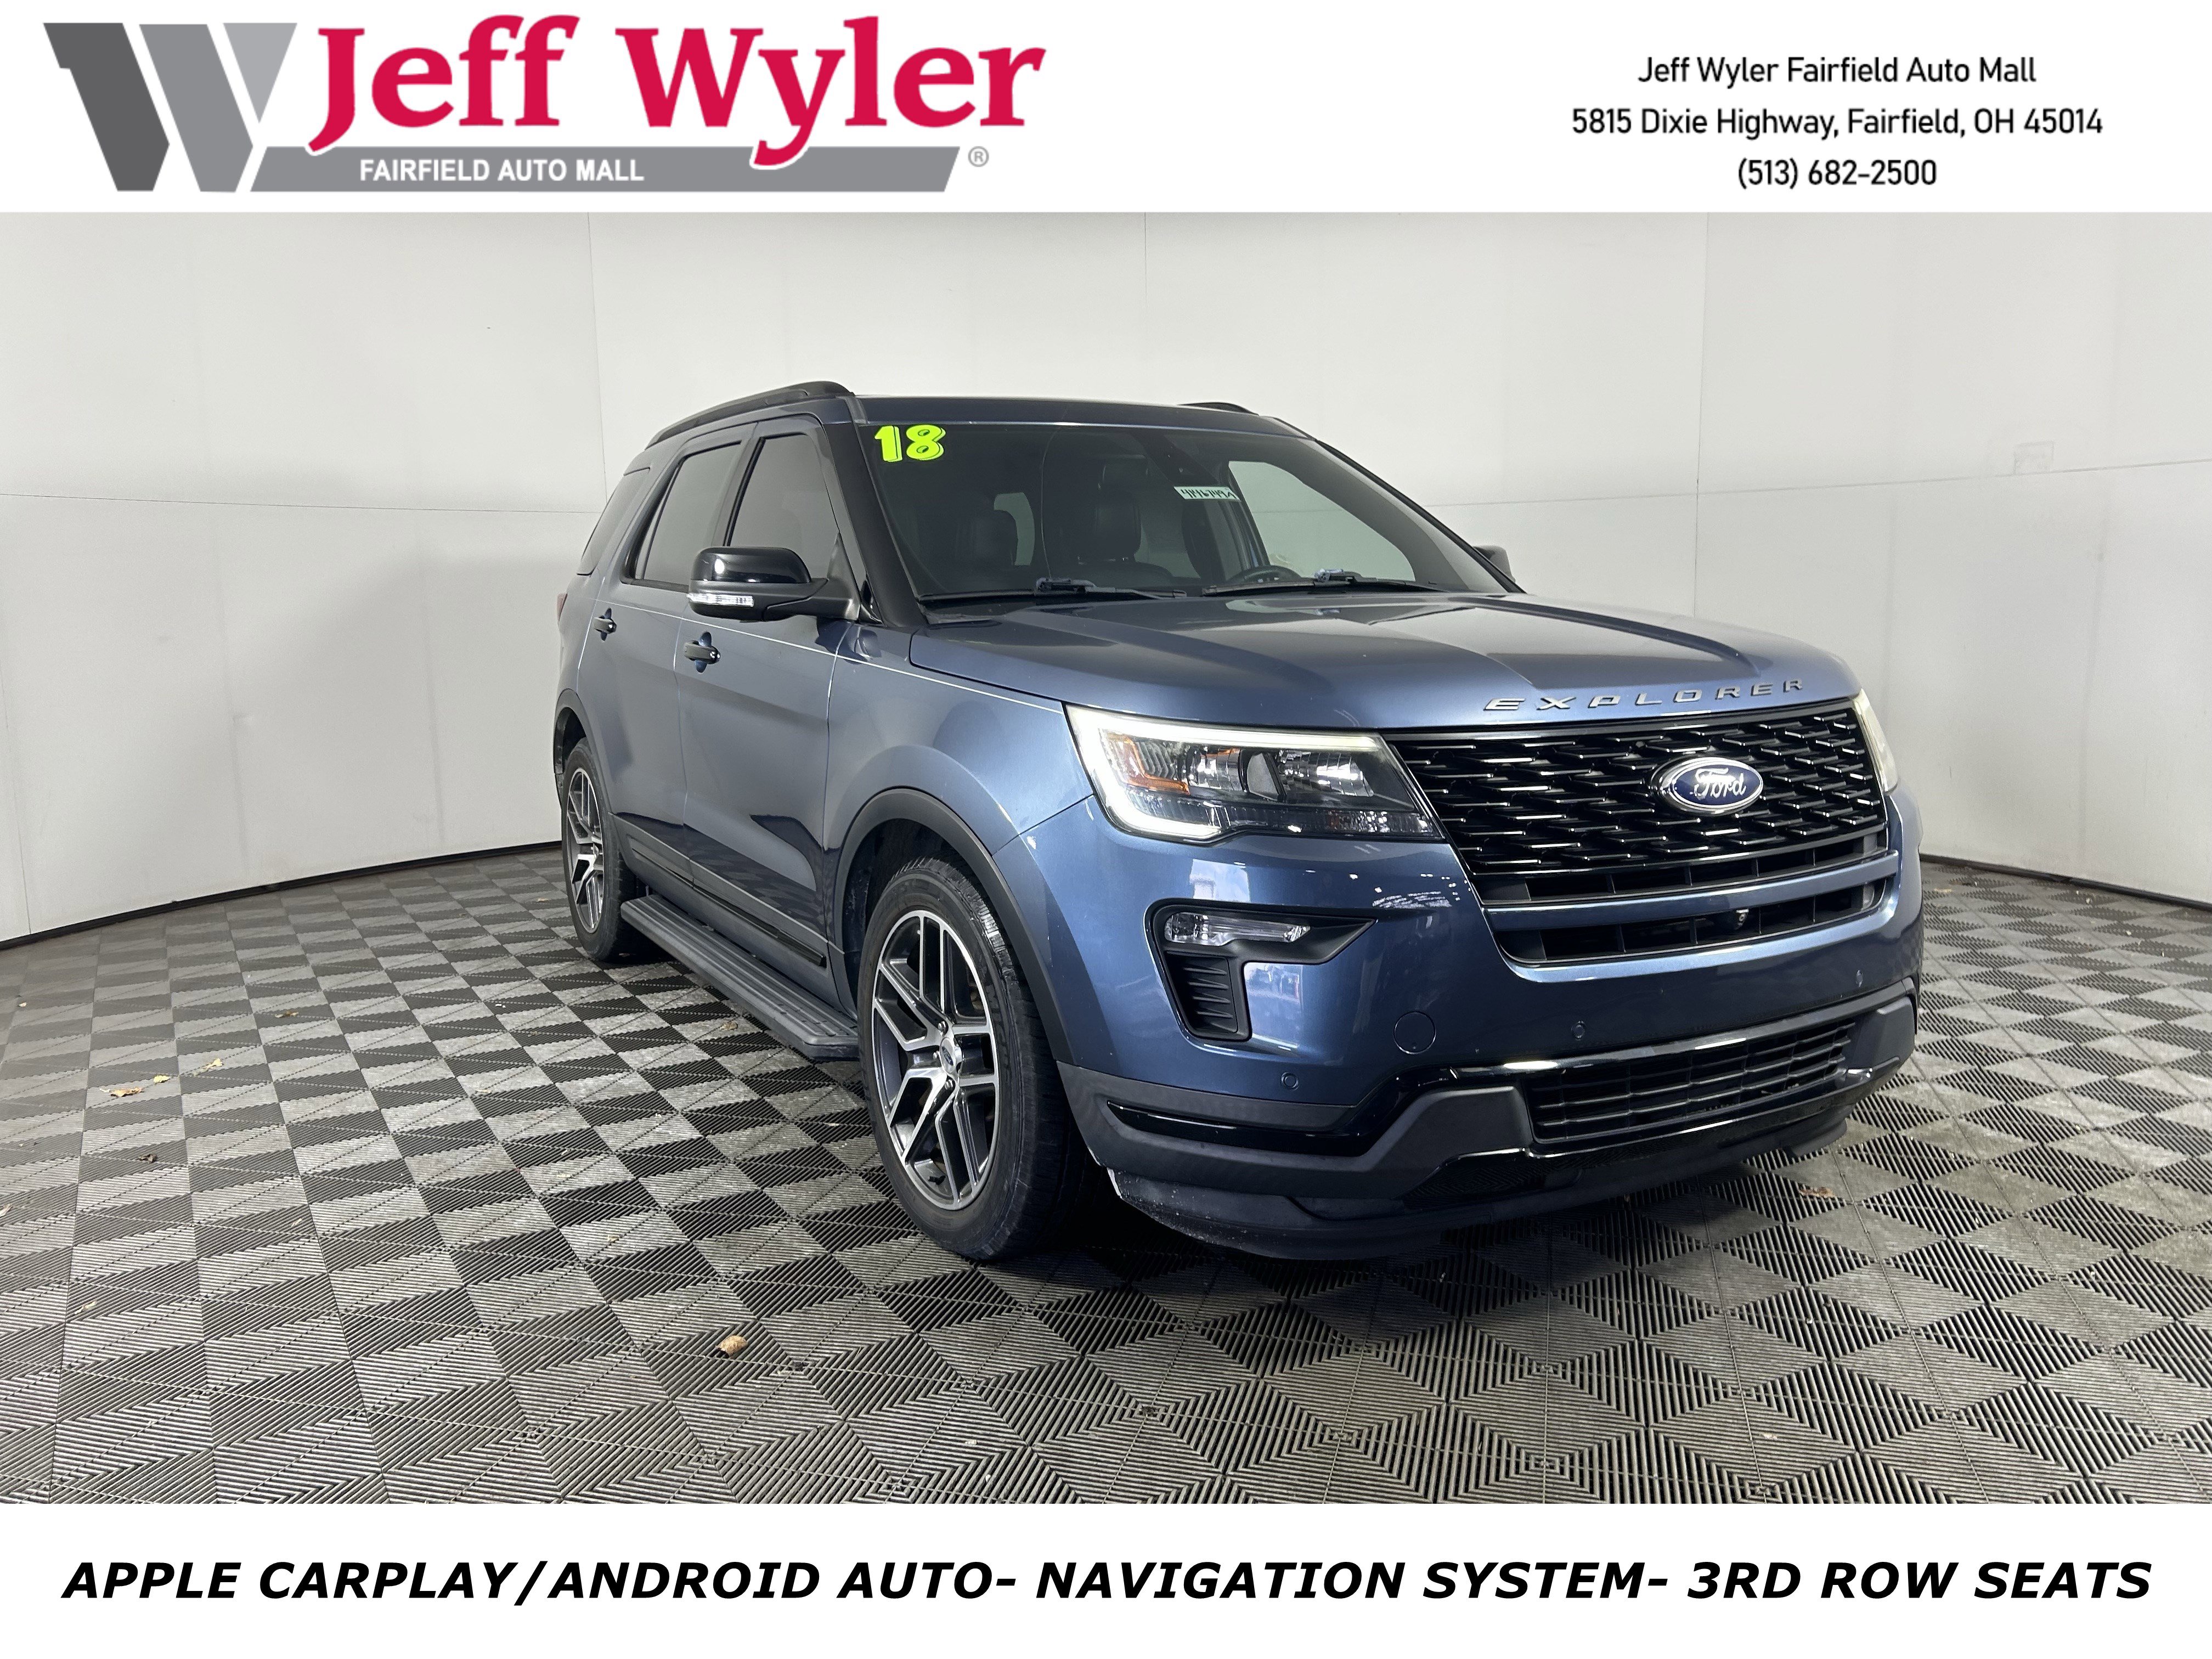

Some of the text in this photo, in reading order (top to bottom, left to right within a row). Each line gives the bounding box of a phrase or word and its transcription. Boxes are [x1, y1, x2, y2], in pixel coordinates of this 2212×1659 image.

[874, 424, 946, 462] 18
[1483, 679, 1803, 710] EXPLORER
[1690, 767, 1747, 800] Ford
